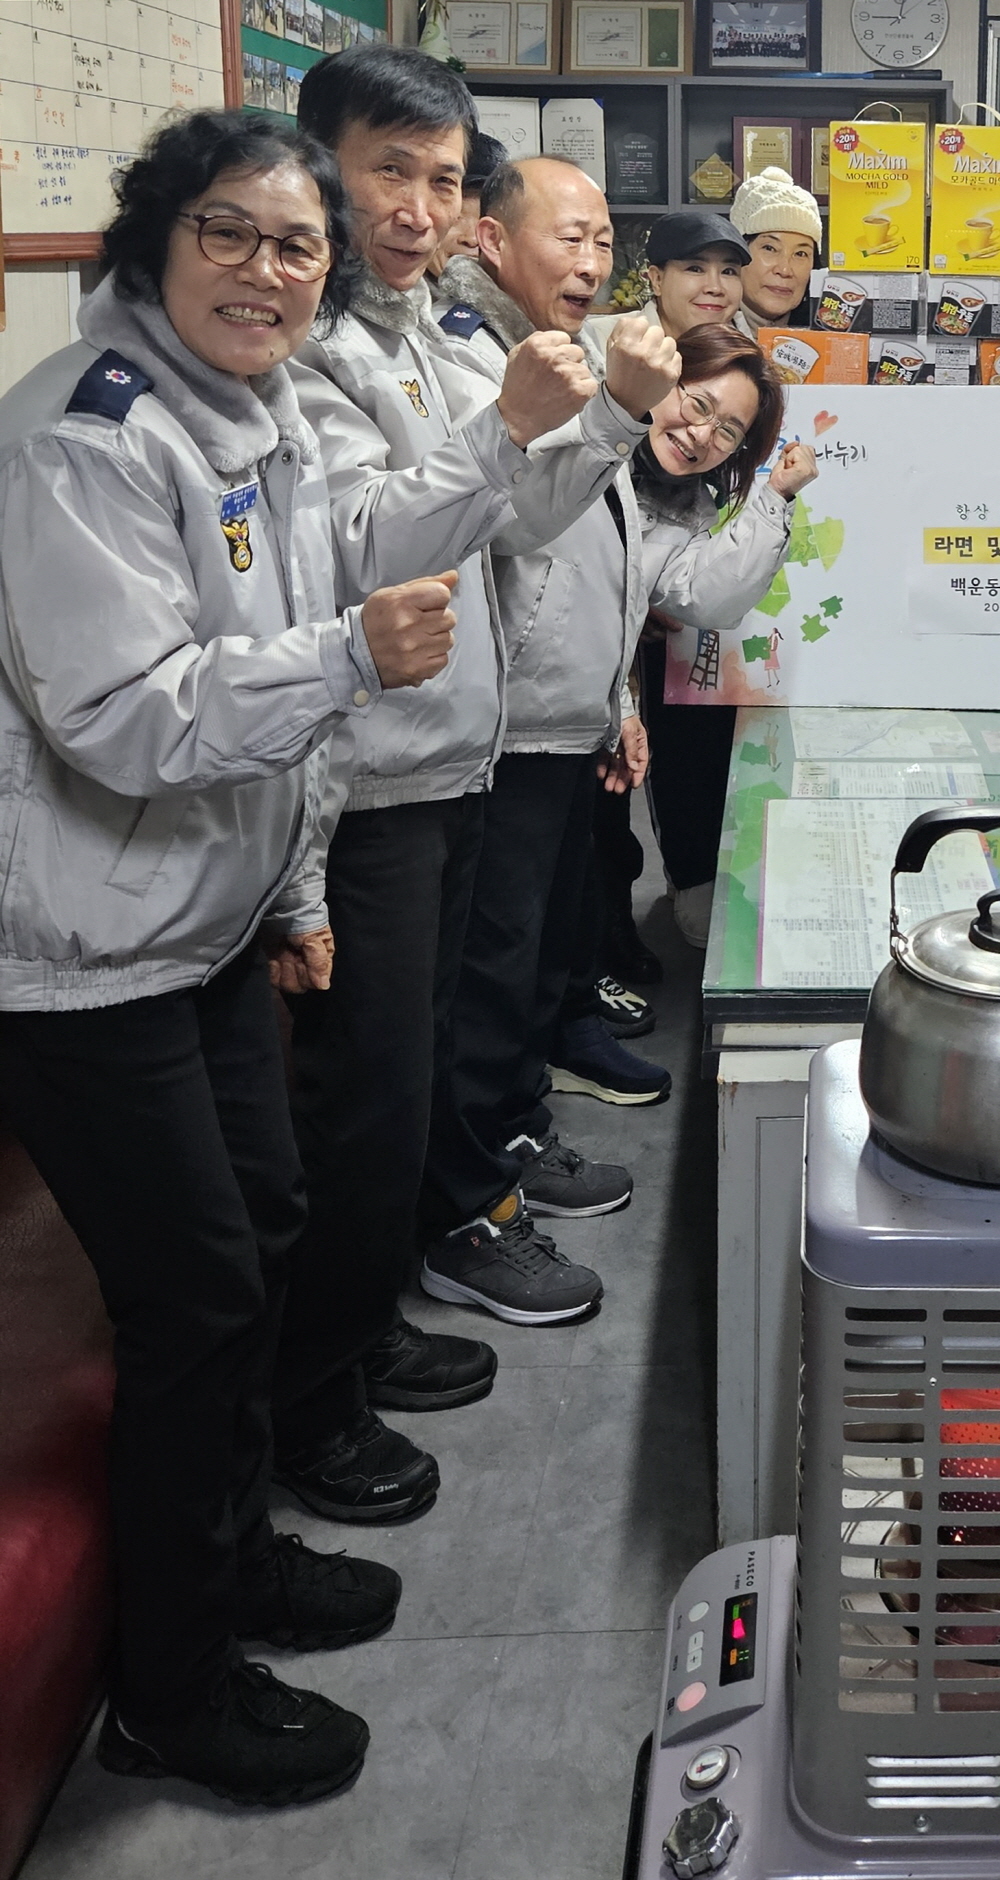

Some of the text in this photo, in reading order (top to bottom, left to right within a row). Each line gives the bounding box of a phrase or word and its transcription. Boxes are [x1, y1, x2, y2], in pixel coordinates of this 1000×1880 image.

[859, 11, 870, 21] 9
[930, 13, 941, 23] 3
[863, 29, 874, 40] 8
[924, 32, 934, 42] 4
[876, 44, 886, 54] 7
[912, 45, 922, 55] 5
[893, 50, 904, 60] 6
[848, 150, 908, 170] Maxim
[845, 172, 909, 181] MOCHA GOLD
[865, 181, 889, 189] MILD
[906, 255, 920, 265] 170
[956, 503, 989, 520] 항상
[934, 536, 973, 557] 라면
[951, 577, 1000, 597] 백운동
[746, 1551, 756, 1587] PASECO
